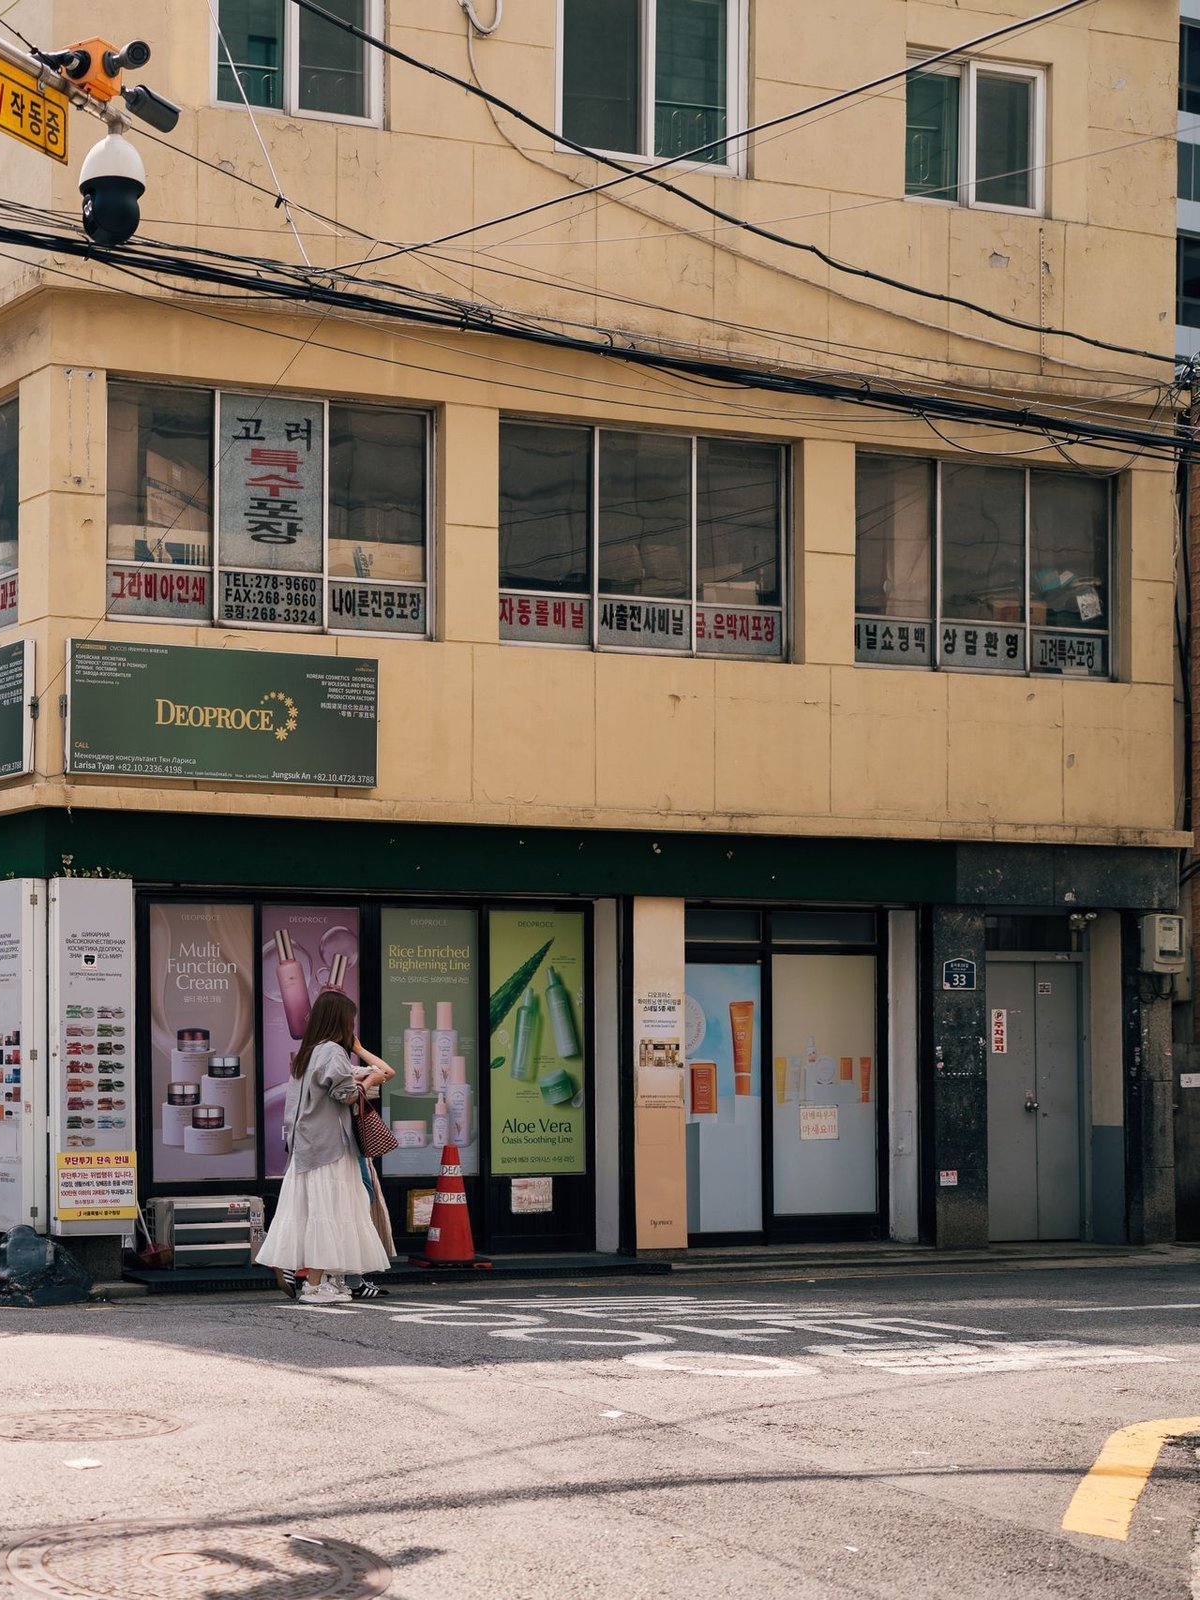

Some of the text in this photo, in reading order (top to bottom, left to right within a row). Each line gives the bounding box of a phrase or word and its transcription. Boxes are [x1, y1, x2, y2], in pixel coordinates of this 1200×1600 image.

[10, 89, 61, 147] 작동중
[232, 417, 312, 451] 고려
[244, 448, 304, 545] 특수포장
[110, 571, 206, 606] 그라비아인쇄
[224, 572, 317, 592] TEL:278-9660
[224, 588, 317, 608] FAX:268-9660
[331, 588, 421, 620] 나이론진공포장
[224, 605, 317, 624] 공장:268-3324
[500, 598, 584, 630] 자동롤비닐
[600, 603, 684, 636] 사출전사비닐
[943, 628, 1019, 660] 상담환영
[1039, 638, 1096, 669] 고려특수포장
[156, 698, 274, 731] DEOPROCE
[74, 741, 90, 749] CALL
[74, 761, 96, 770] Larisa
[97, 762, 115, 771] Tyan
[115, 755, 157, 763] консультант
[171, 757, 197, 765] Лариса
[271, 770, 300, 781] Jungsuk
[301, 772, 311, 780] An
[181, 914, 222, 922] DEOPROCE
[289, 916, 328, 924] DEOPROCE
[410, 918, 448, 927] DEOPROCE
[179, 942, 220, 958] Multi
[388, 944, 470, 958] Rice Enriched
[167, 958, 237, 974] Function
[388, 959, 470, 973] Brightening Line
[176, 975, 229, 990] Cream
[952, 974, 966, 986] 33
[994, 1021, 1004, 1052] 주차금지
[501, 1118, 572, 1134] Aloe Vera
[501, 1136, 573, 1146] Oasis Soothing Line
[64, 1155, 129, 1165] 무단투기 단속 안내
[61, 1171, 88, 1179] 무단투기는
